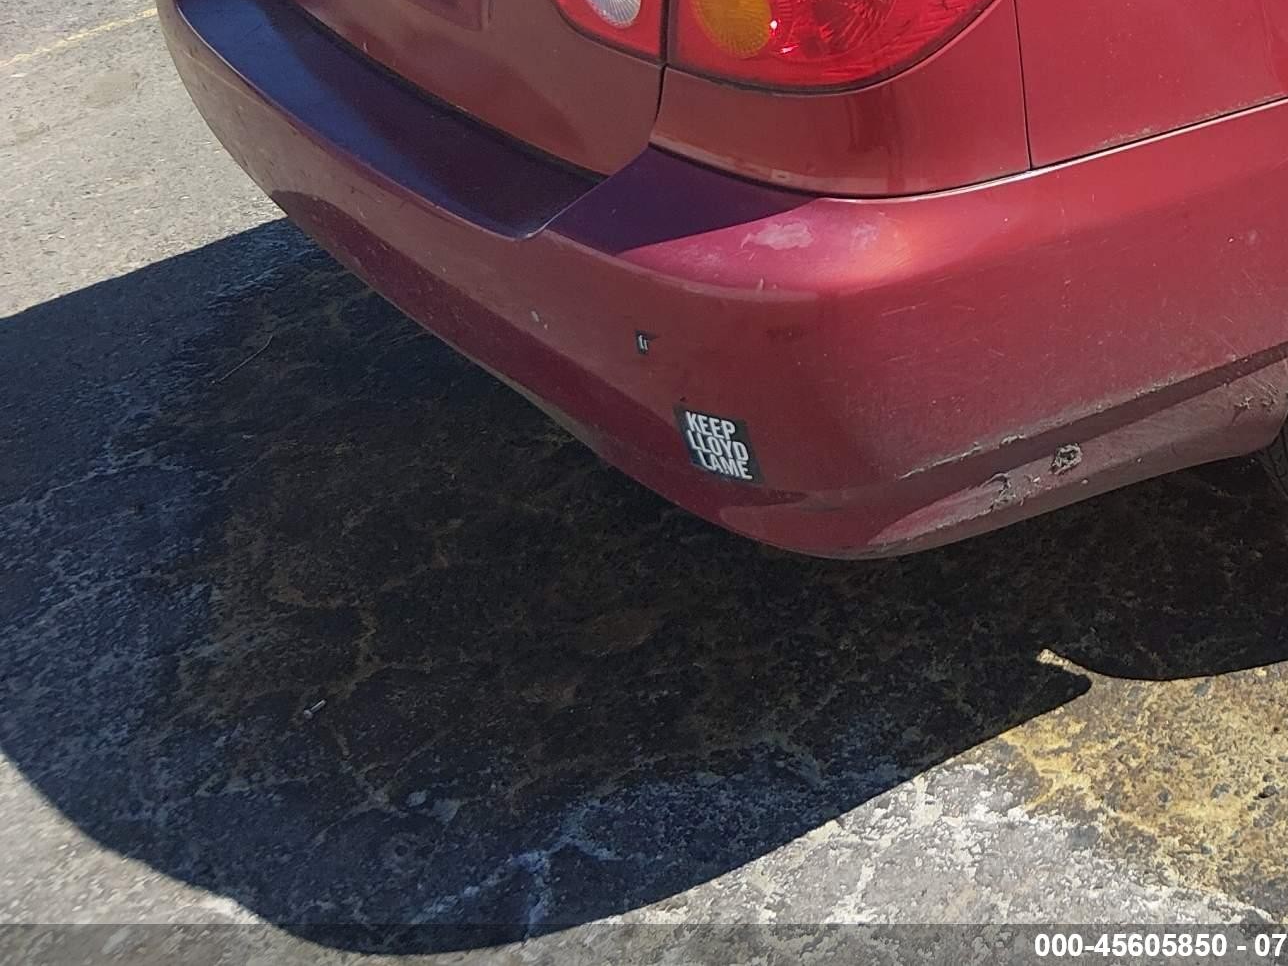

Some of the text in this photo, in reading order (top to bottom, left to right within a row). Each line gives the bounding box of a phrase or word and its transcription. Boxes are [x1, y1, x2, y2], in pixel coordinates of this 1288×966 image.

[685, 410, 736, 441] KEEP
[686, 429, 749, 461] LLOYD
[697, 449, 753, 480] LAME
